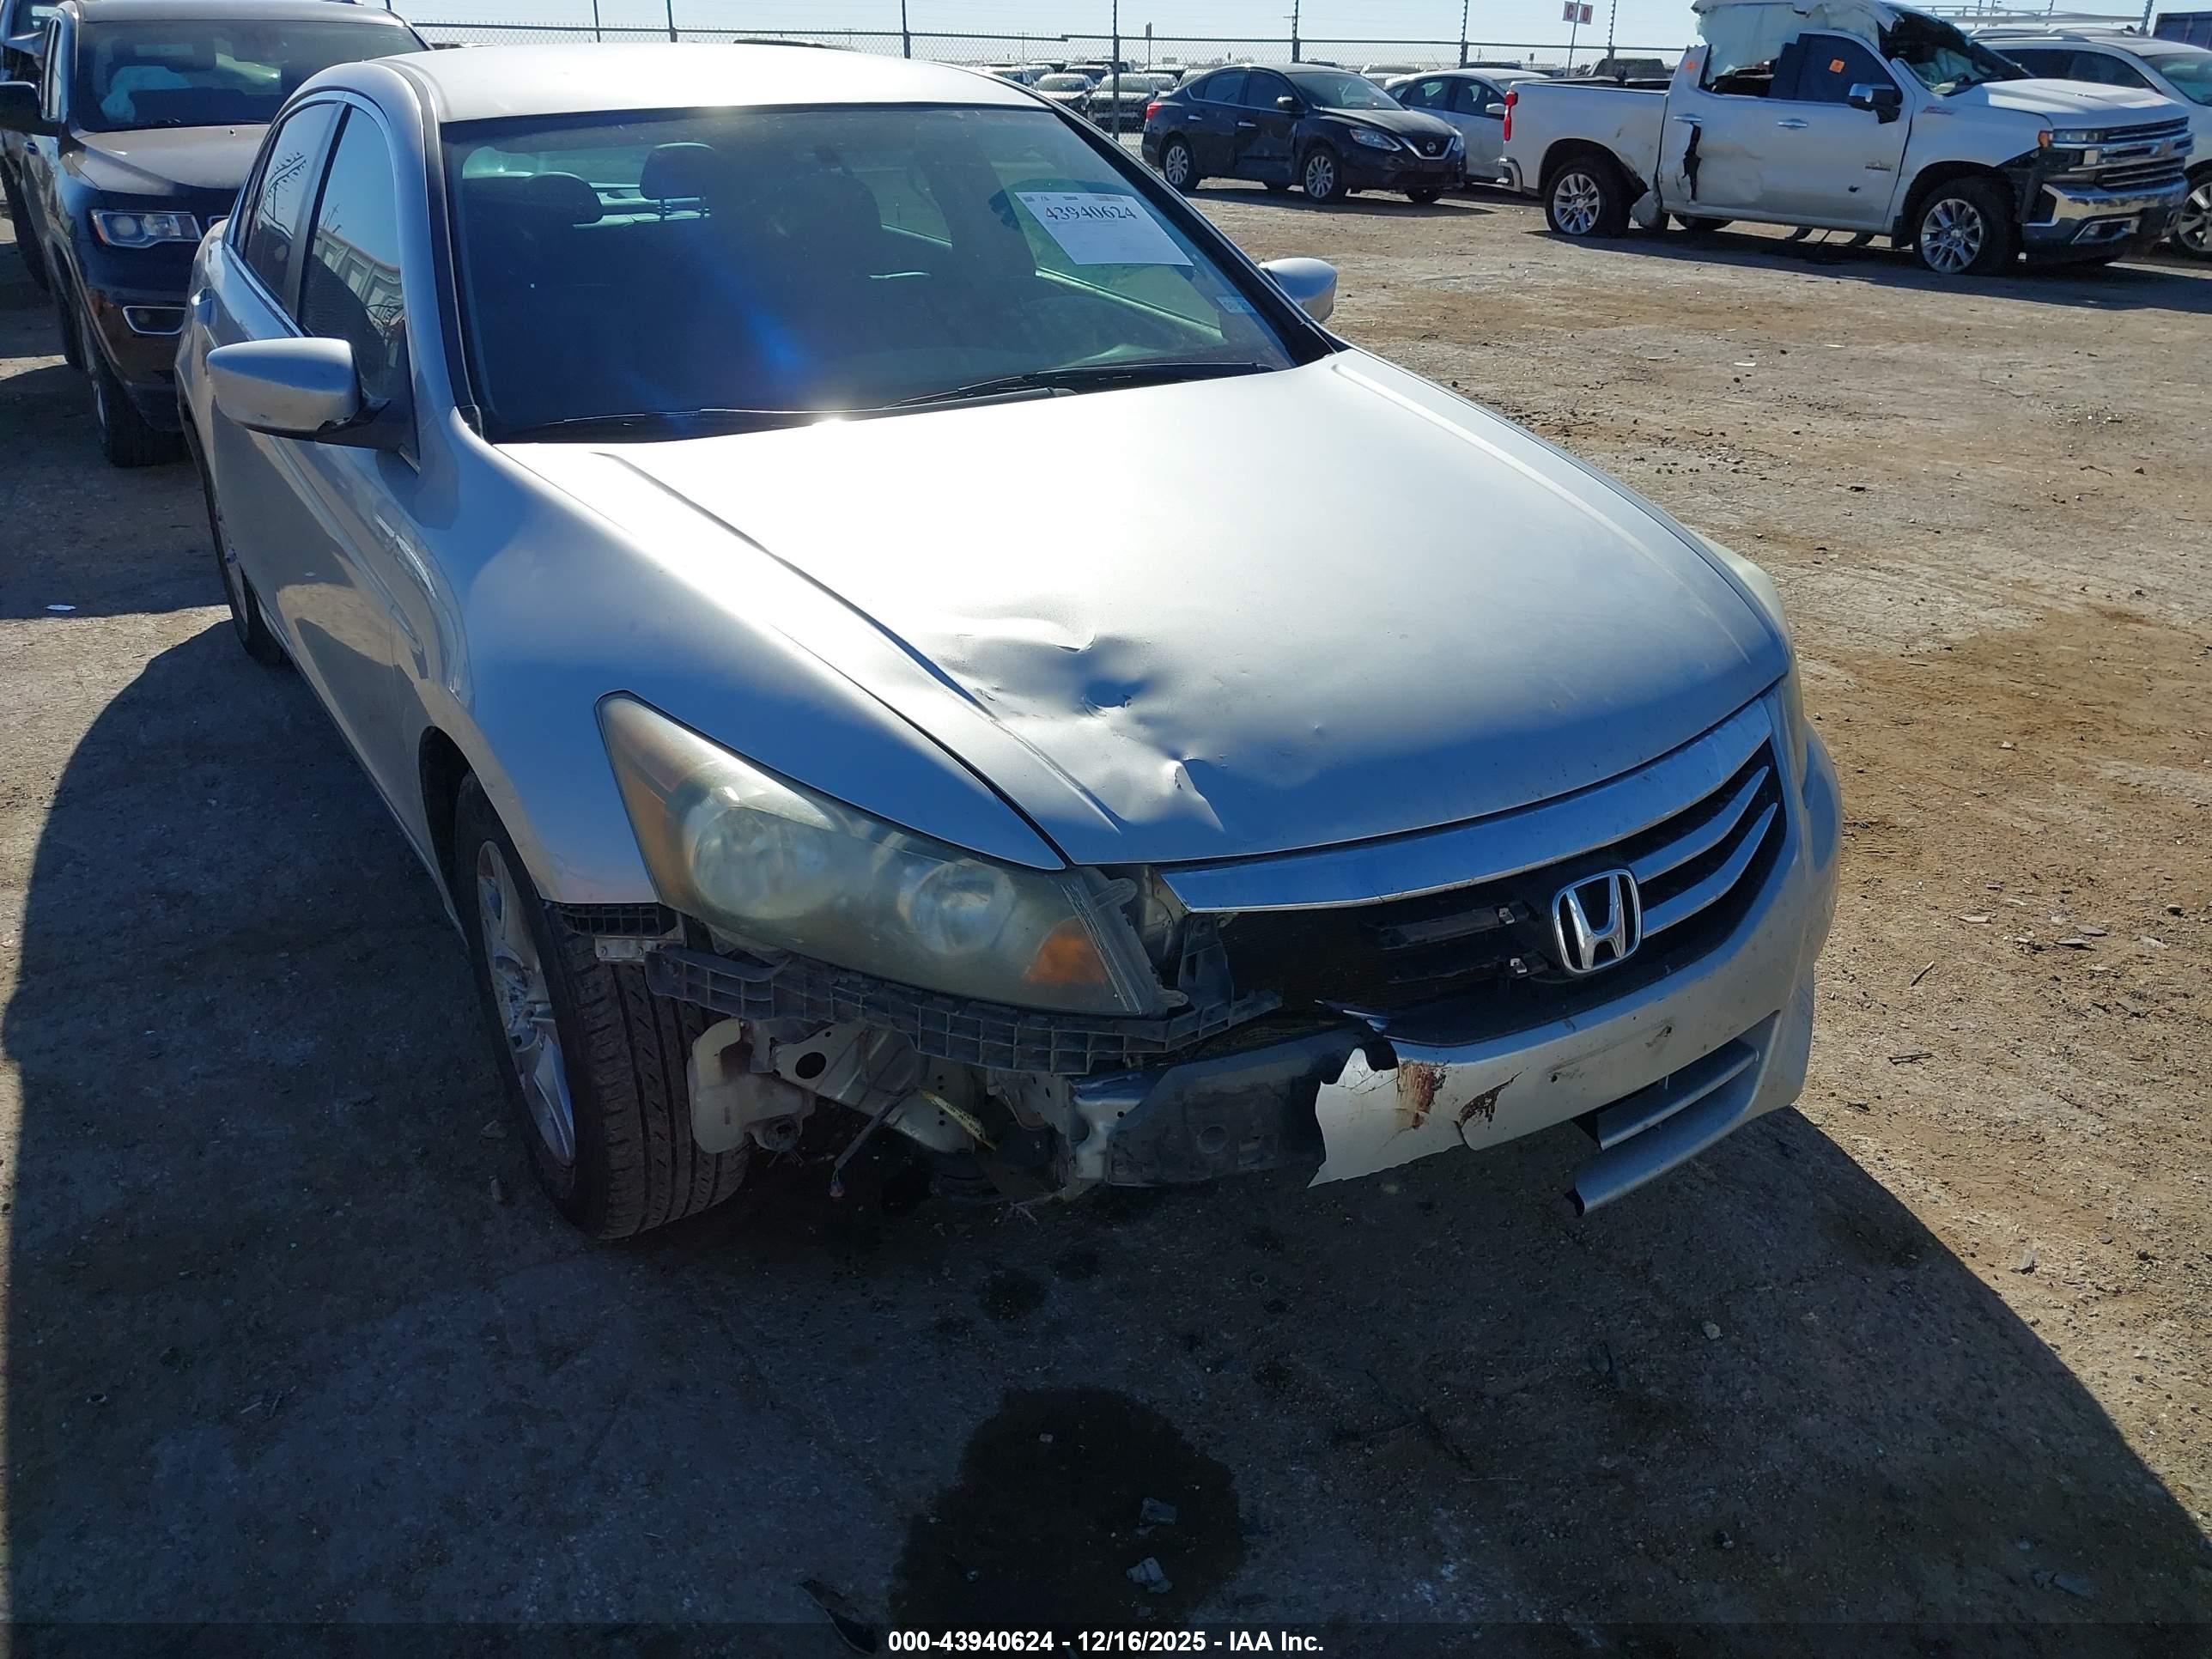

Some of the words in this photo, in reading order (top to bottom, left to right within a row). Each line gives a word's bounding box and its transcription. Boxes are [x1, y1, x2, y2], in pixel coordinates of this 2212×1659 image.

[1566, 3, 1574, 20] C
[1582, 6, 1589, 22] D
[1046, 206, 1138, 220] 43940624
